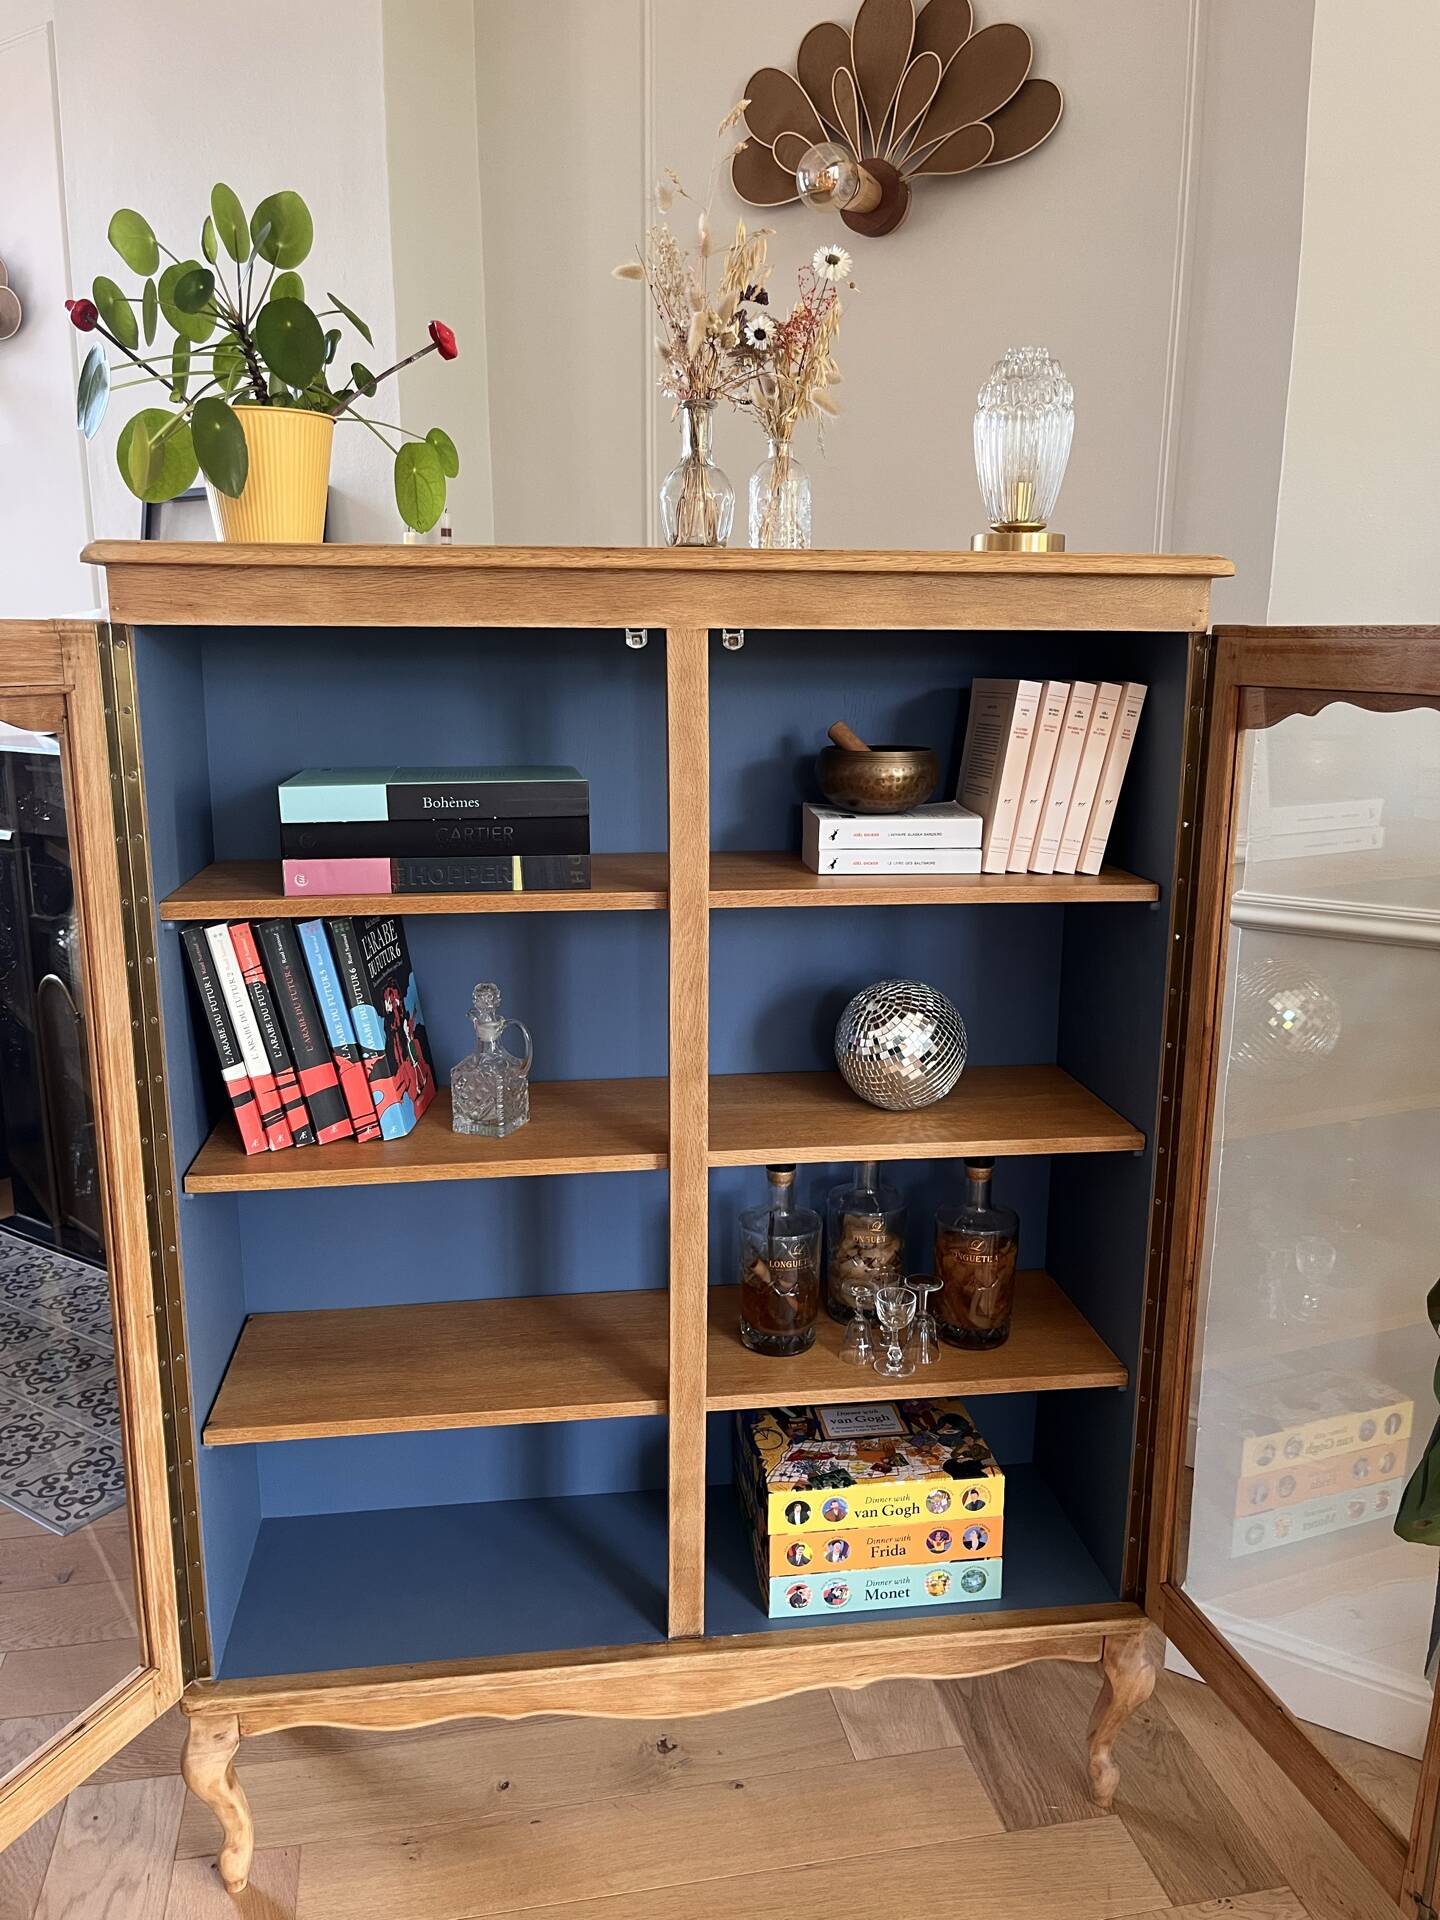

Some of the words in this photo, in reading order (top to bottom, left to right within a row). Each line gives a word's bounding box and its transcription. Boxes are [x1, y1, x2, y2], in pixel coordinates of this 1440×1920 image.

[422, 796, 480, 809] Bohèmes
[436, 826, 514, 841] CARTIER
[409, 863, 513, 886] HOPPER
[361, 919, 398, 960] L'ARABE
[374, 945, 397, 972] FUTUR
[395, 942, 401, 957] 6
[284, 970, 298, 1001] FUTUR
[321, 976, 336, 1006] FUTUR
[350, 974, 364, 1005] FUTUR
[204, 980, 219, 1012] FUTUR
[229, 978, 244, 1008] FUTUR
[240, 1009, 248, 1023] DU
[260, 1007, 273, 1021] DU
[294, 1002, 302, 1016] DU
[331, 1007, 340, 1020] DU
[212, 1013, 223, 1026] DU
[854, 1414, 890, 1423] Gogh
[865, 1496, 891, 1504] Dinner
[894, 1493, 911, 1502] with
[854, 1509, 878, 1518] van
[881, 1502, 920, 1518] Gogh
[866, 1537, 892, 1545] Dinner
[894, 1534, 912, 1542] with
[871, 1543, 907, 1559] Frida
[865, 1579, 892, 1588] Dinner
[894, 1576, 911, 1585] with
[865, 1588, 910, 1601] Monet
